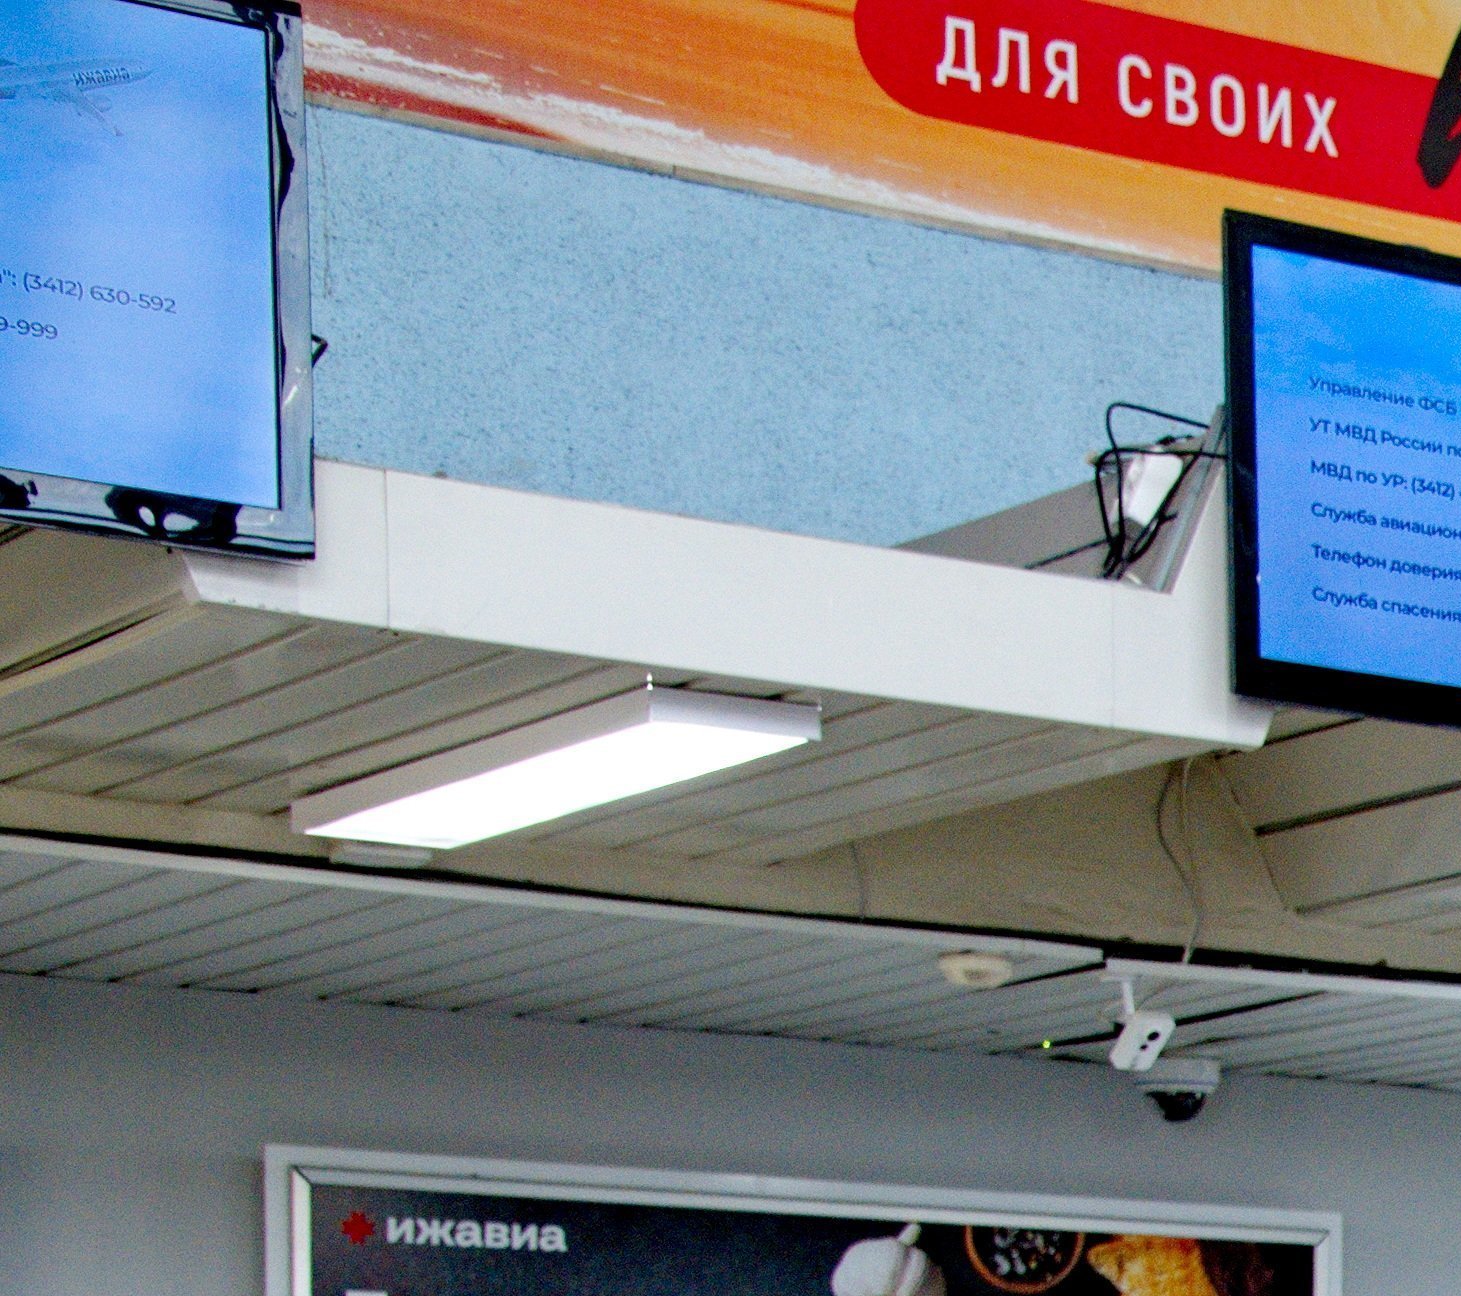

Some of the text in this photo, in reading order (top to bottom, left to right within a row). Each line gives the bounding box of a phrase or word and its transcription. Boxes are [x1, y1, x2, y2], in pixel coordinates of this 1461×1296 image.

[23, 270, 84, 301] (3412)
[90, 284, 178, 315] 630-592
[1309, 375, 1415, 409] Управление
[1417, 396, 1457, 415] ФСБ
[1308, 417, 1331, 435] УТ
[1335, 421, 1378, 446] МВД
[1382, 430, 1443, 455] России
[1311, 459, 1353, 482] МВД
[1356, 469, 1378, 485] по
[1411, 477, 1455, 502] (3412)
[1310, 501, 1378, 527] Служба
[1311, 543, 1388, 572] Телефон
[1311, 585, 1379, 611] Служба
[384, 1215, 569, 1253] ижавиа
